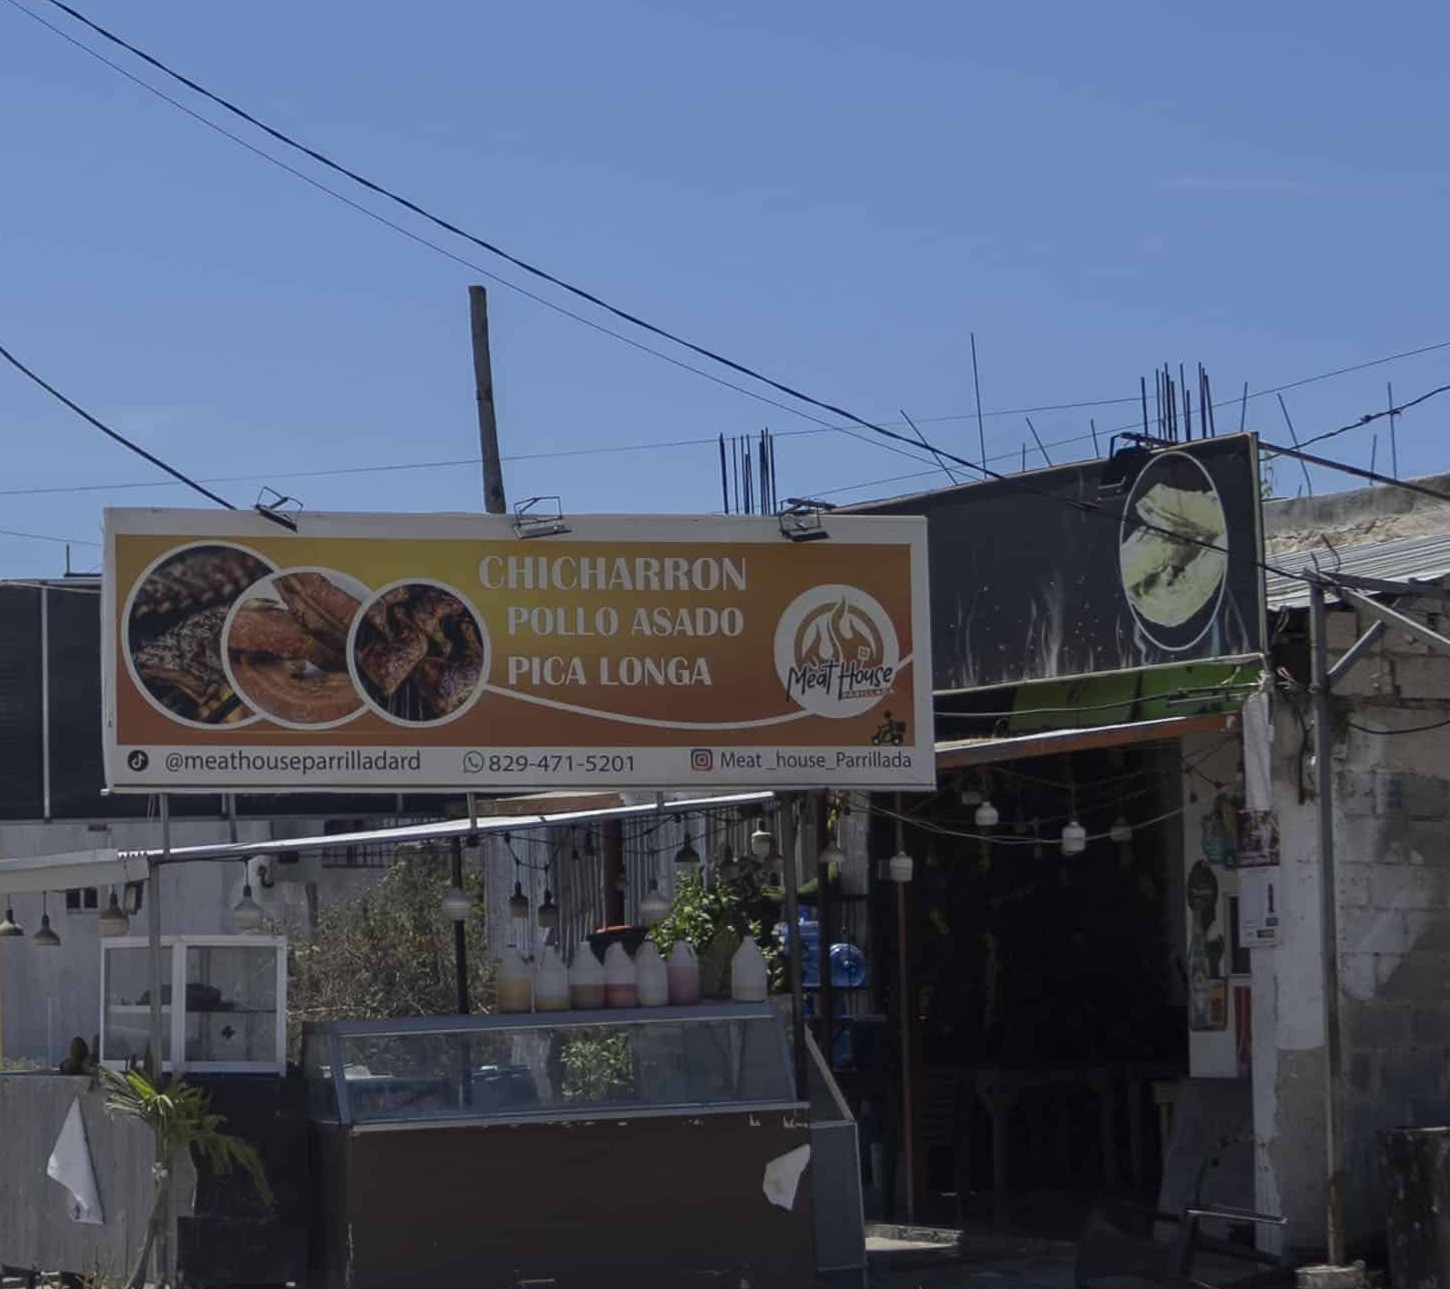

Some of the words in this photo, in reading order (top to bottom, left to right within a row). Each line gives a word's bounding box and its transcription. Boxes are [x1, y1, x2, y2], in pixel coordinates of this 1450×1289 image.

[478, 555, 747, 591] CHICHARRON
[507, 606, 619, 637] POLLO
[631, 606, 744, 637] ASADO
[507, 656, 587, 686] PICA
[600, 656, 713, 686] LONGA
[785, 660, 839, 702] Meat
[838, 661, 893, 700] House
[165, 750, 422, 775] @meathouseparrilladard
[488, 755, 635, 773] 829-471-5201
[720, 751, 763, 769] Meat
